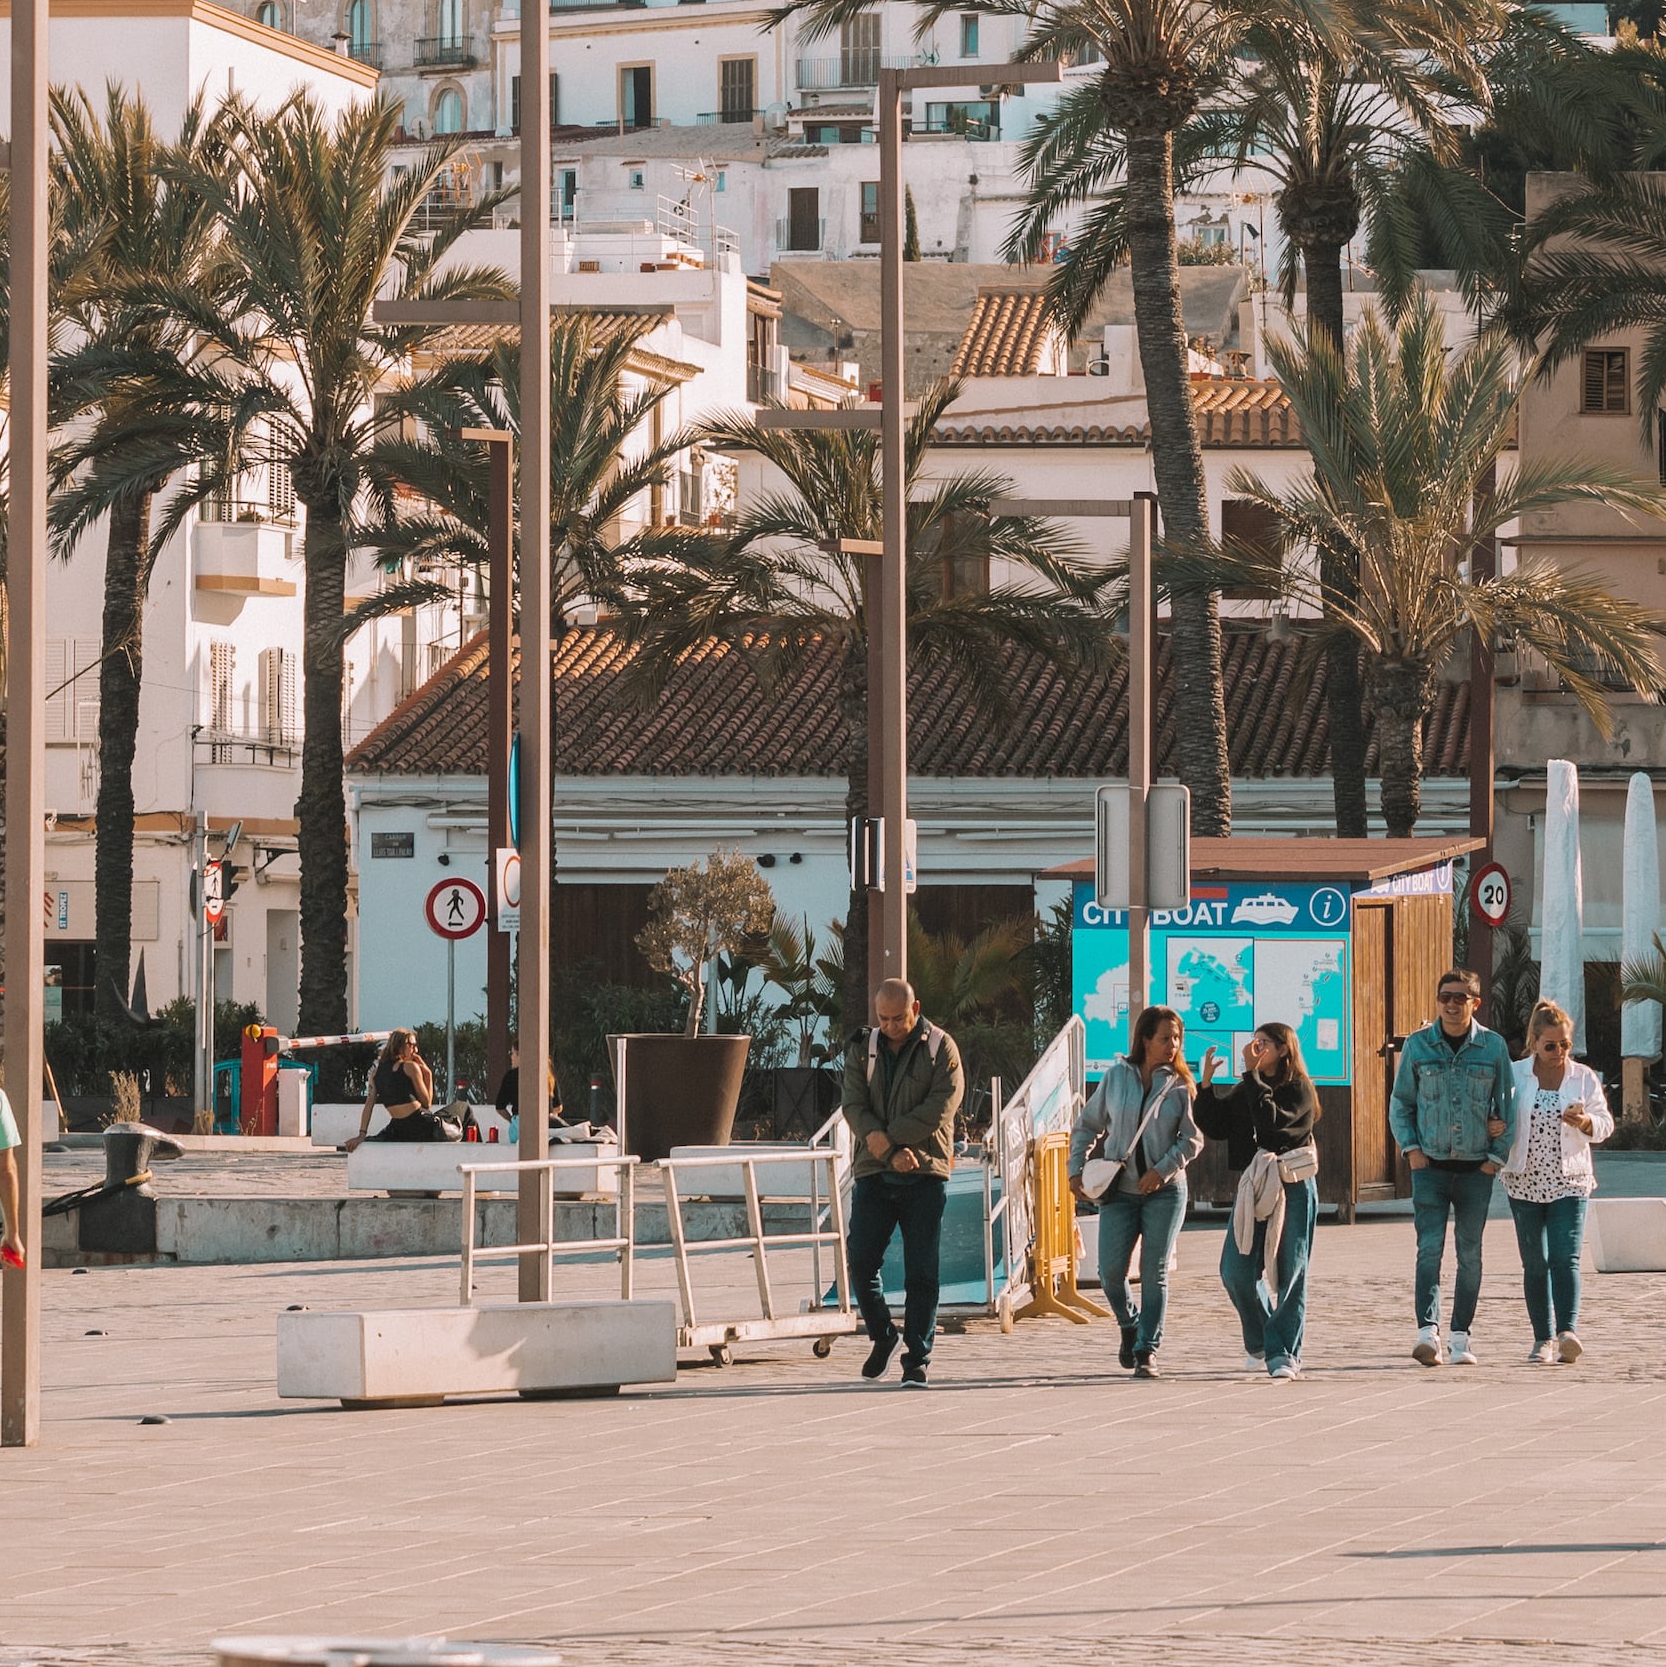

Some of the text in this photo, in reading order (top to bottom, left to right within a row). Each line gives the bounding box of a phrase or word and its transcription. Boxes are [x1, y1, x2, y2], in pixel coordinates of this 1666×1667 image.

[1392, 872, 1411, 892] CITY
[1412, 871, 1435, 892] BOAT
[59, 893, 67, 918] TROPEZ
[1484, 884, 1504, 905] 20
[1082, 902, 1129, 925] CIT
[1153, 901, 1228, 926] BOAT
